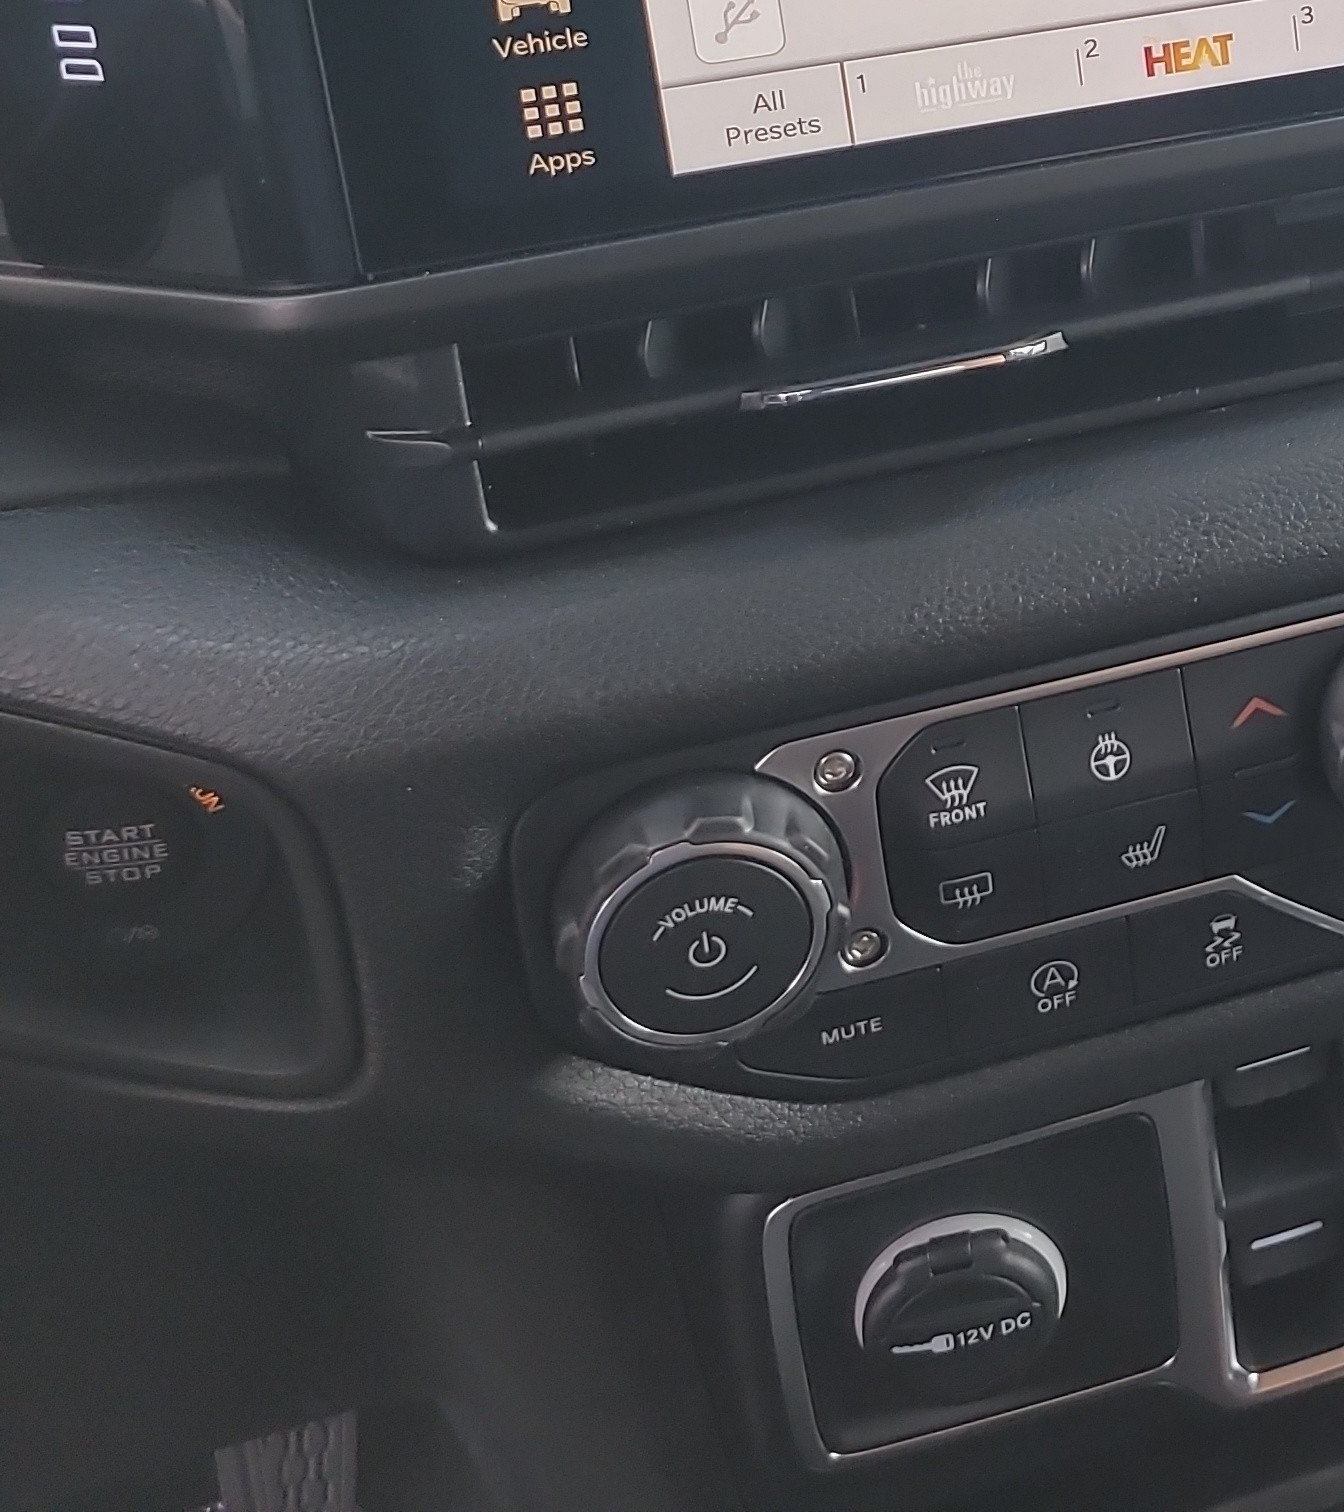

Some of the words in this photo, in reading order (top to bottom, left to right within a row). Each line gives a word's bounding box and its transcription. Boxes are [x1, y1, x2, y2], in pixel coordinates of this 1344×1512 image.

[1300, 6, 1314, 24] 3
[51, 23, 104, 82] DO
[491, 27, 589, 59] Vehicle
[1083, 38, 1100, 59] 2
[1142, 32, 1234, 78] HEAT
[957, 60, 982, 80] the
[856, 74, 867, 93] 1
[914, 73, 1016, 109] highway
[752, 90, 787, 115] All
[725, 115, 822, 148] Presets
[528, 147, 597, 178] Apps
[928, 801, 988, 828] FRONT
[65, 823, 156, 846] START
[64, 842, 169, 867] ENGINE
[85, 863, 162, 885] STOP
[657, 895, 740, 933] VOLUME
[1205, 945, 1244, 968] OFF
[1037, 992, 1078, 1014] OFF
[820, 1016, 884, 1046] MUTE
[956, 1323, 995, 1347] 12V
[1000, 1311, 1032, 1336] DC
